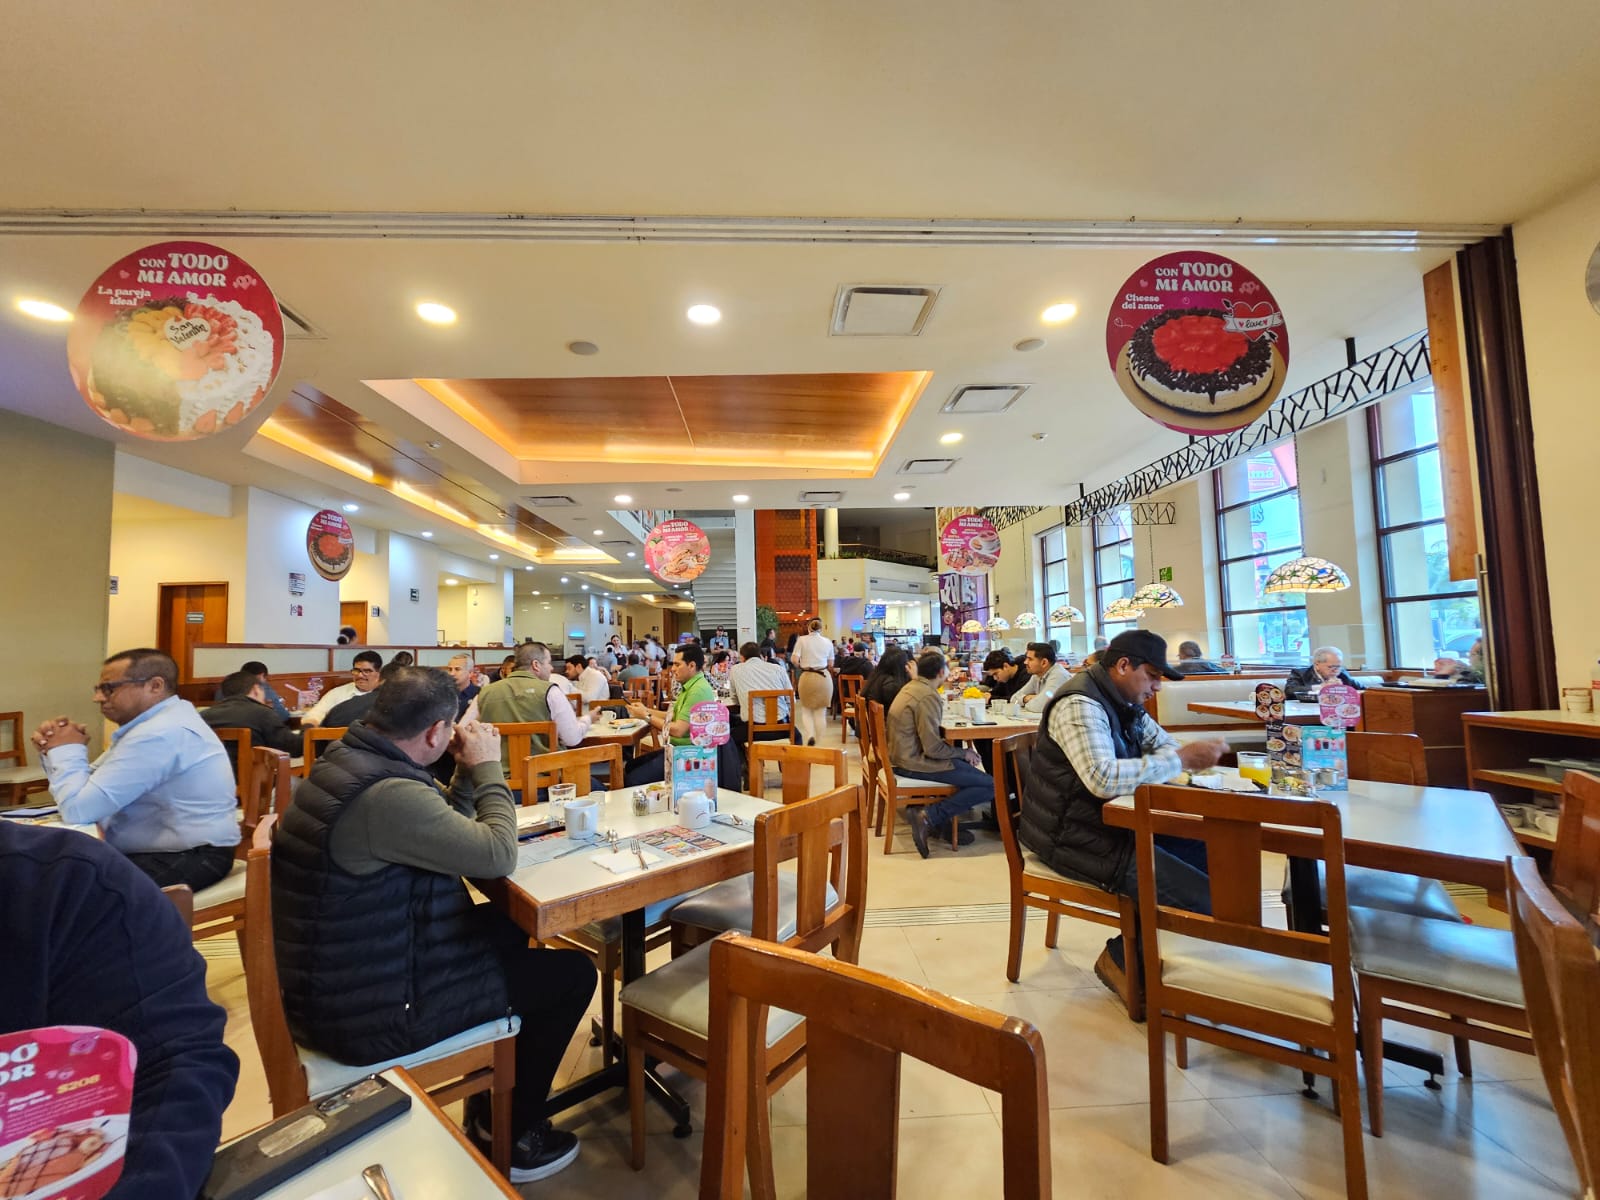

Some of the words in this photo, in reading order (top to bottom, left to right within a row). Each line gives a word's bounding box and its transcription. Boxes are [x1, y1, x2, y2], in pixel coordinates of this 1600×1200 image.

[139, 258, 166, 268] CON
[168, 253, 229, 271] TODO
[1155, 267, 1179, 277] CON
[1180, 262, 1233, 278] TODO
[137, 270, 164, 284] MI
[167, 271, 226, 287] AMOR
[1155, 279, 1179, 291] MI
[1181, 279, 1234, 292] AMOR
[97, 286, 113, 295] La
[114, 287, 151, 299] pareja
[1125, 293, 1160, 302] Cheese
[109, 297, 138, 306] ideal
[1121, 302, 1136, 310] del
